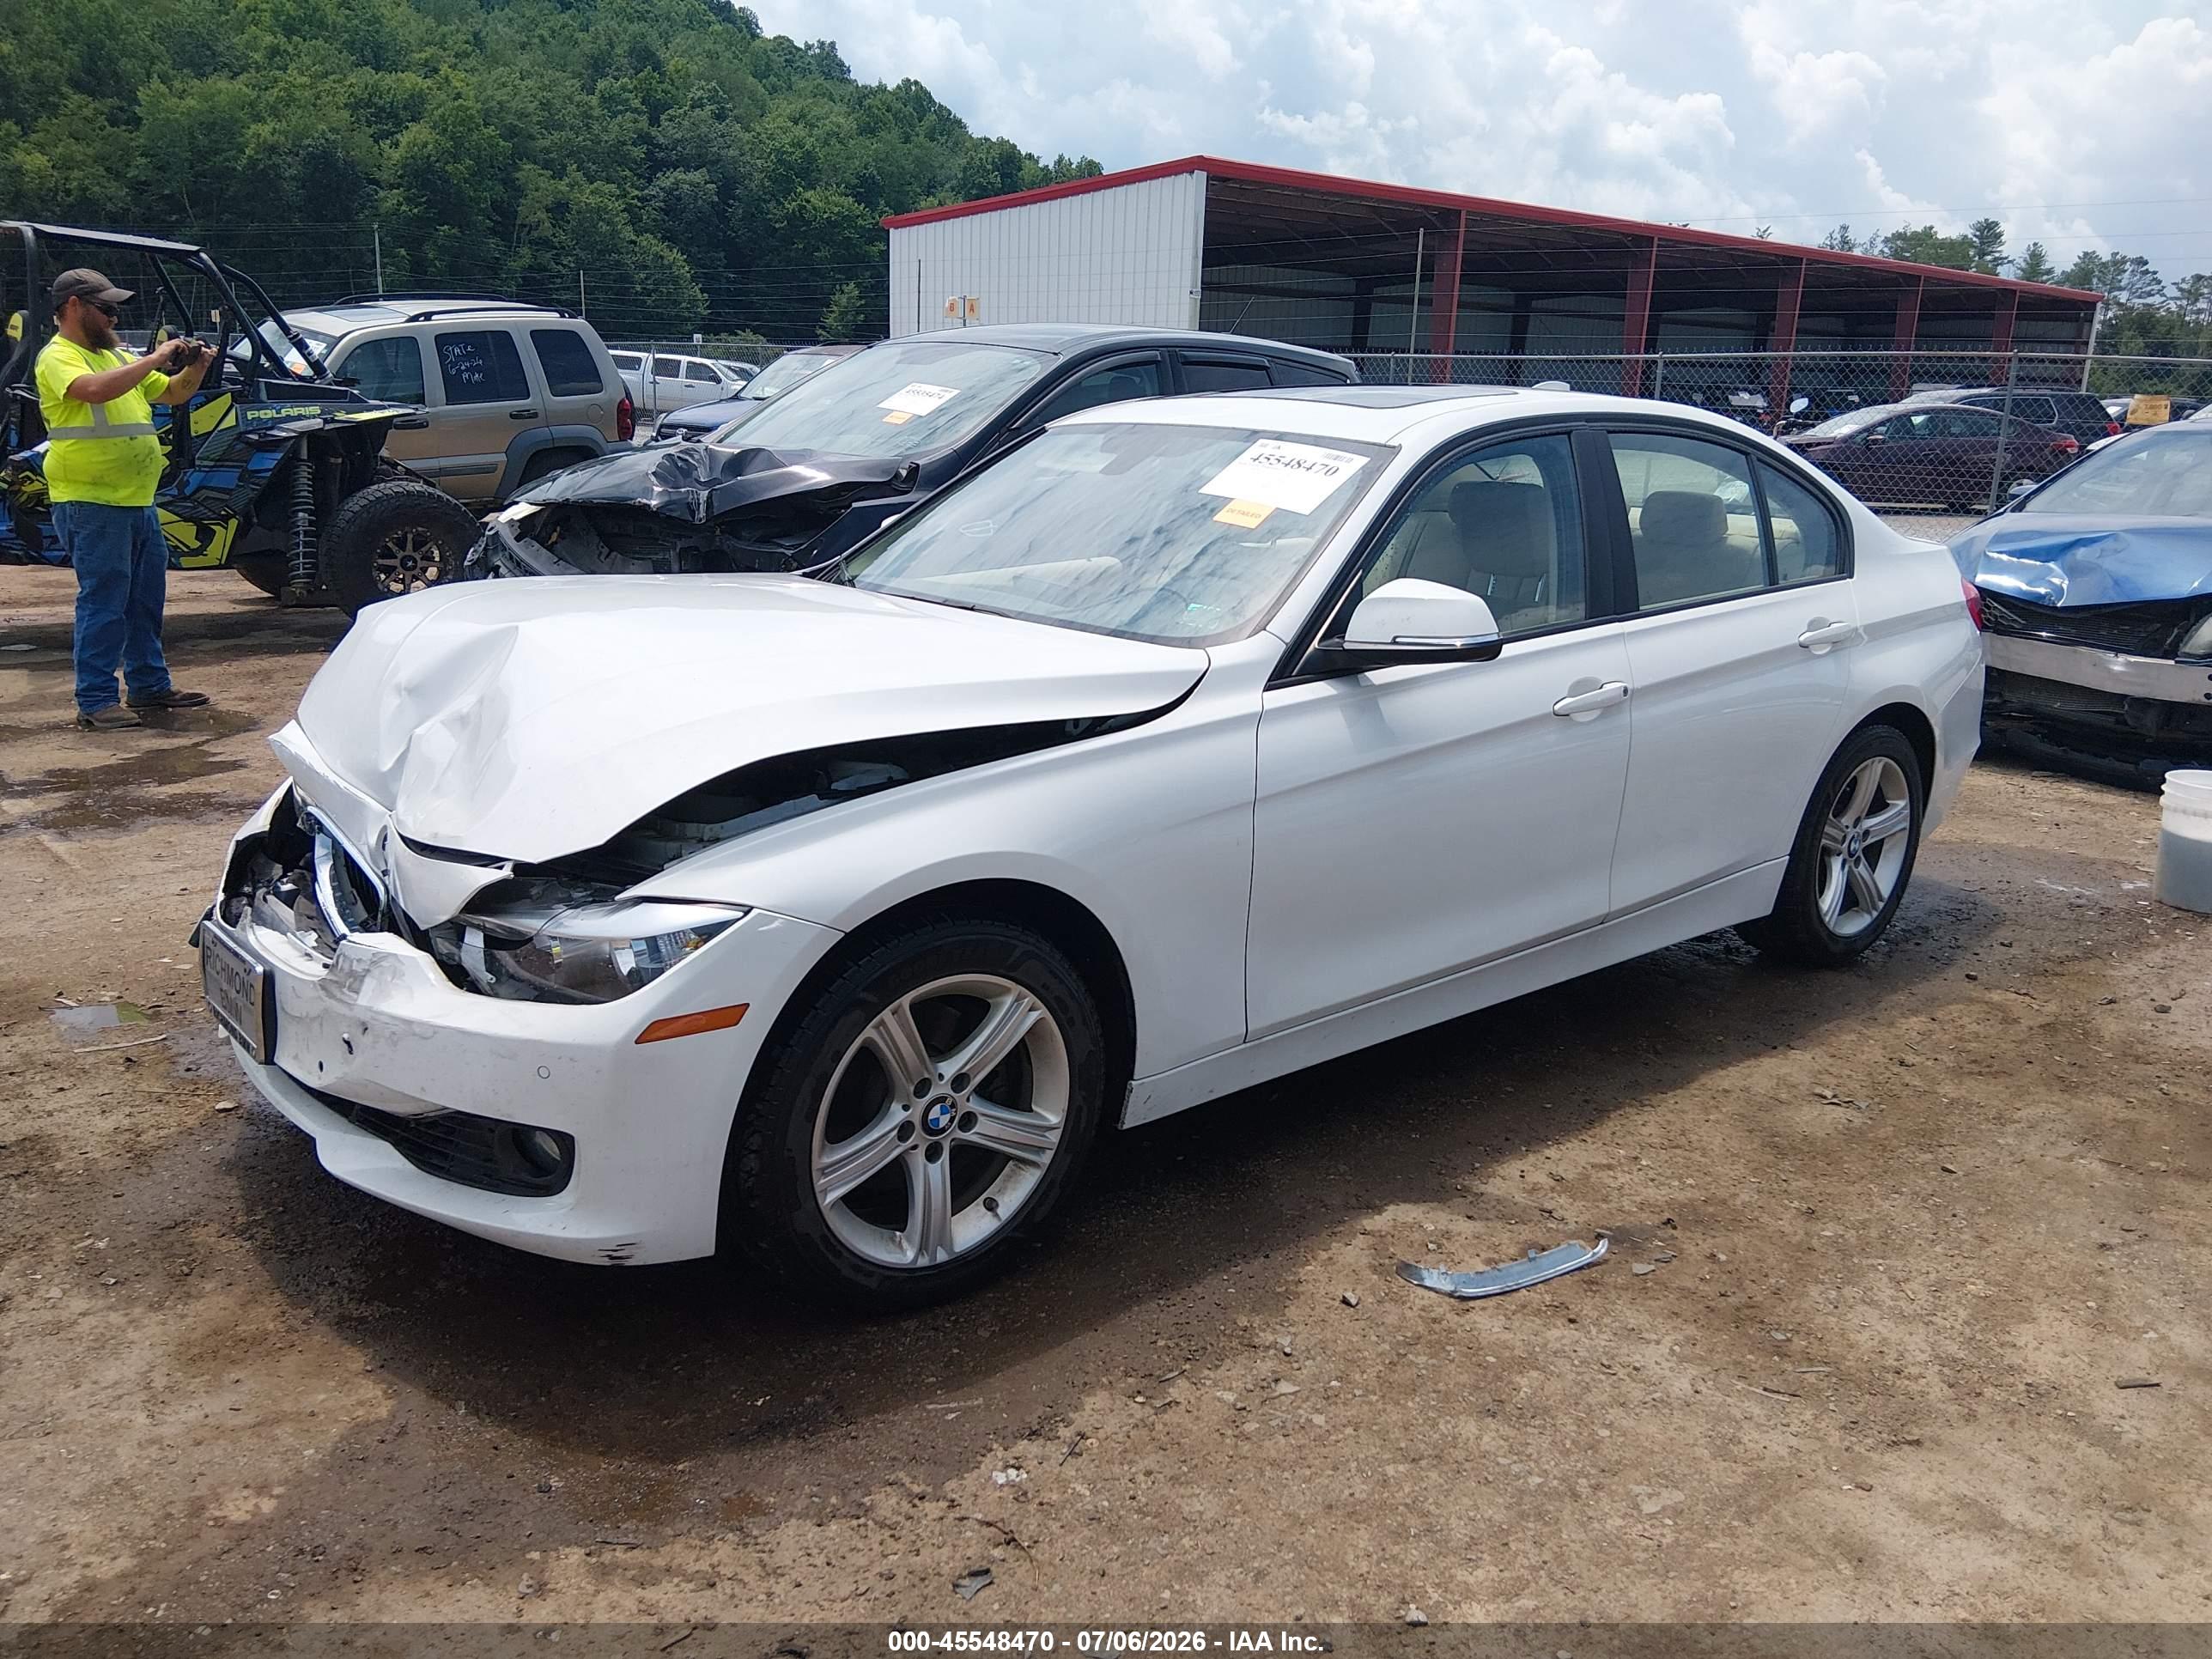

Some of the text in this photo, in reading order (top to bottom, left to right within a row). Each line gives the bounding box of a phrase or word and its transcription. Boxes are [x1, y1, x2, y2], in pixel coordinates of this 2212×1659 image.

[969, 302, 975, 313] A
[246, 405, 321, 420] POLARIS
[1249, 453, 1340, 477] 45548470
[205, 945, 255, 1007] RICHMOND
